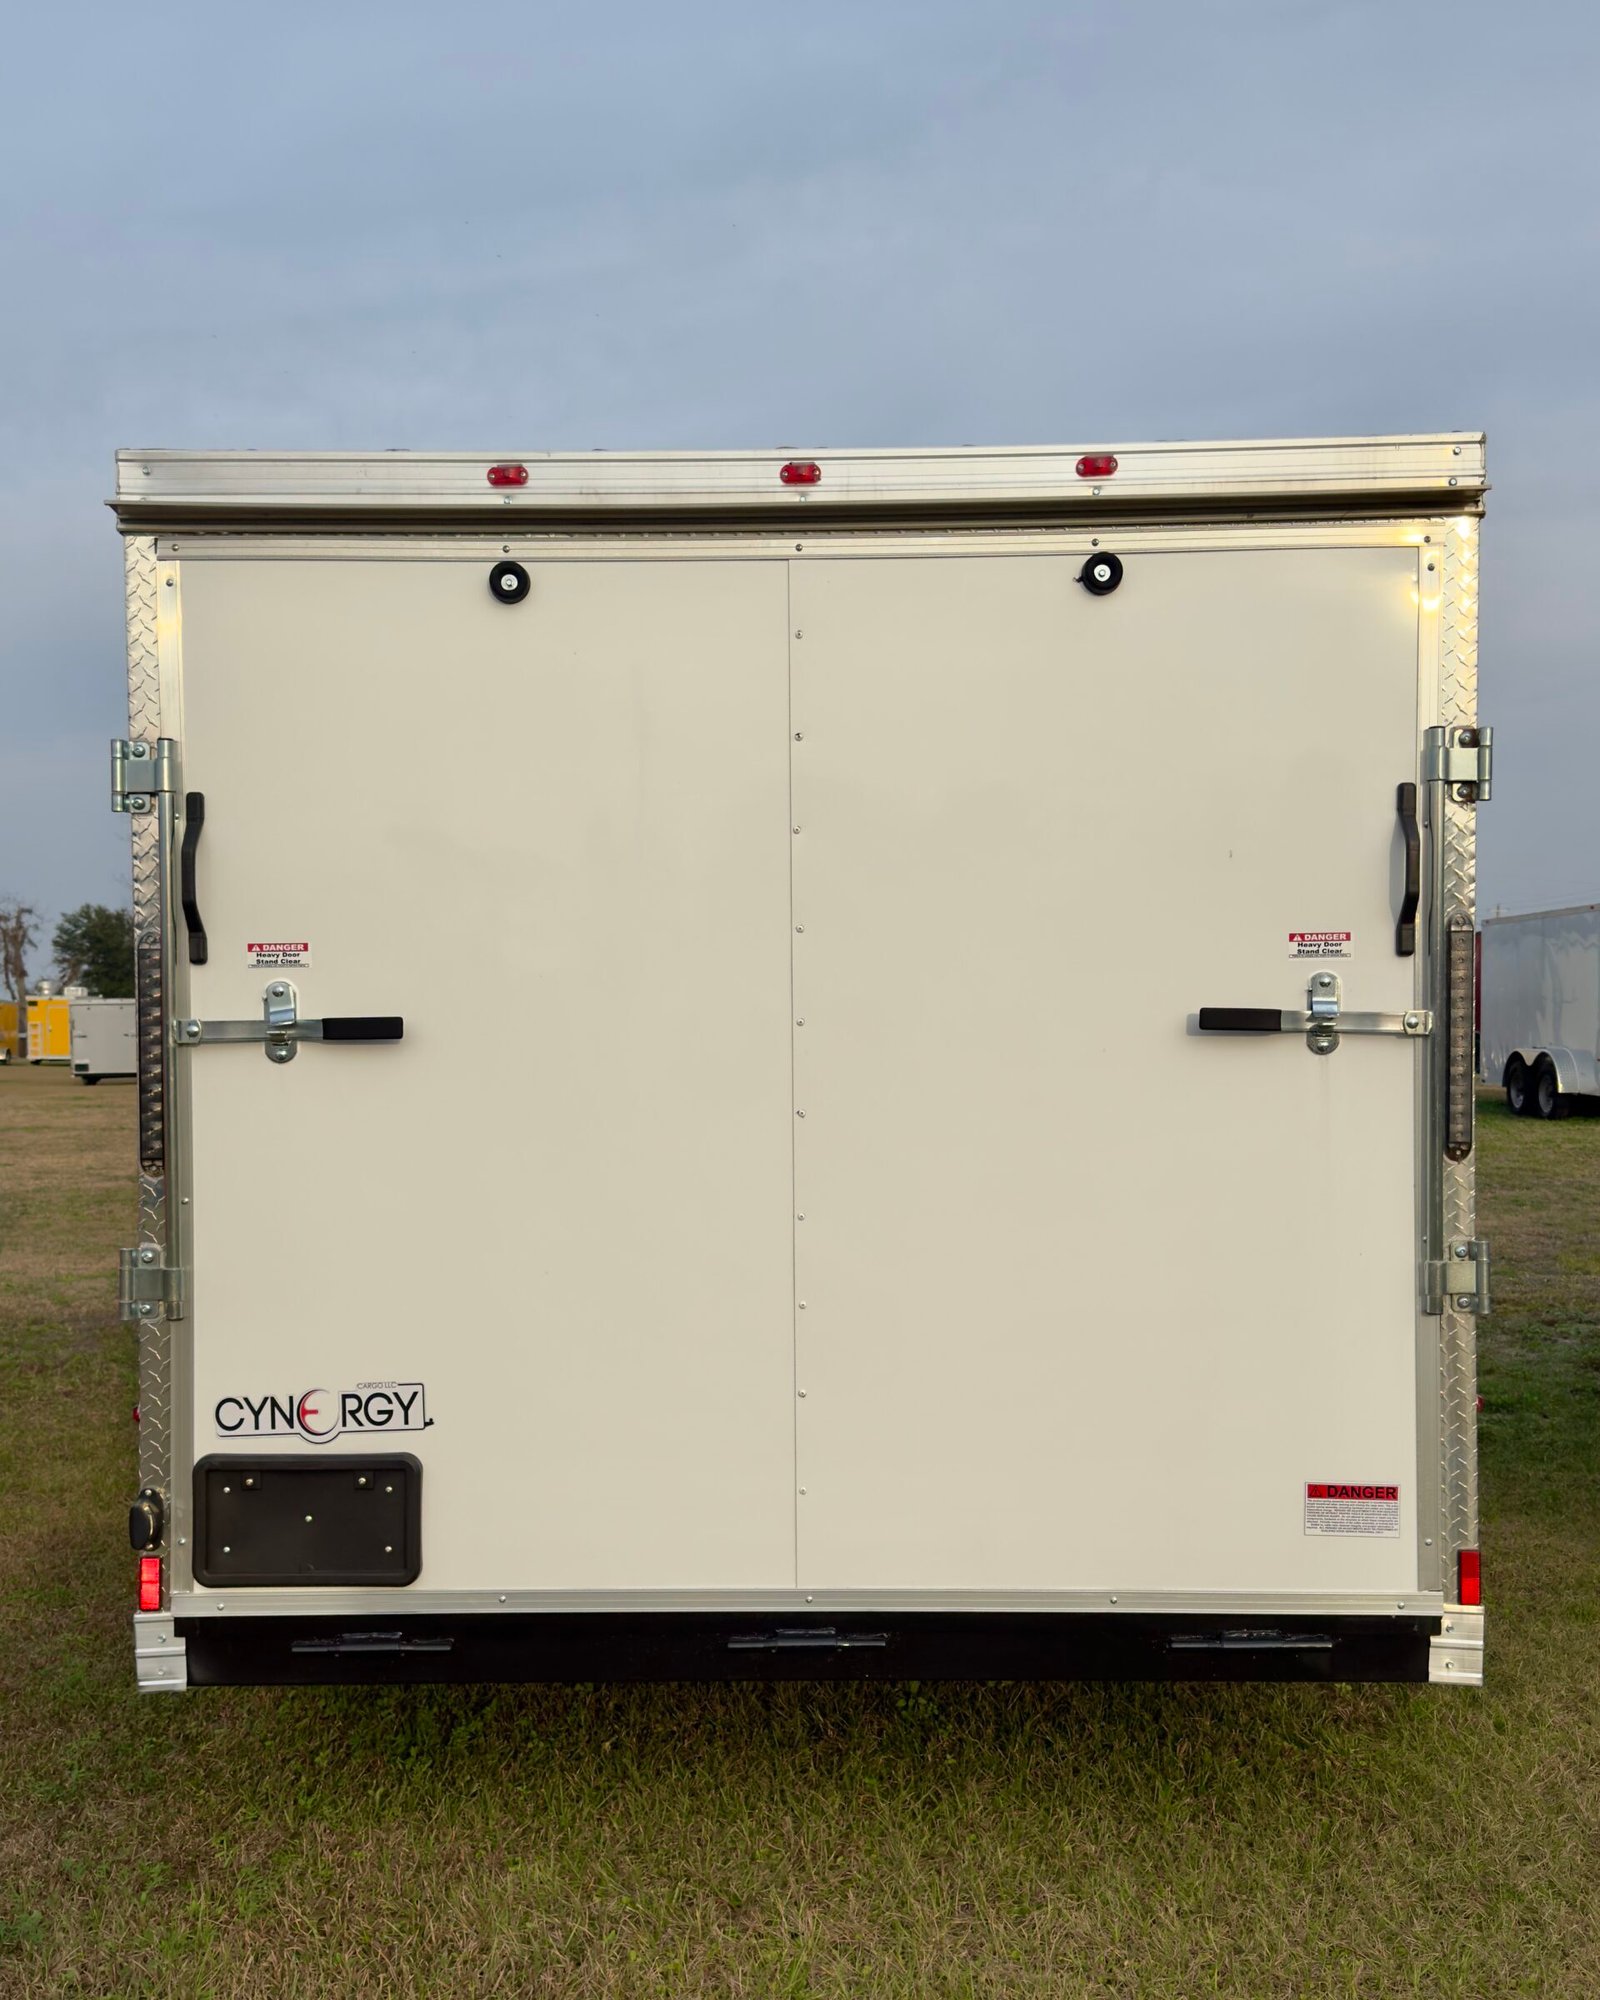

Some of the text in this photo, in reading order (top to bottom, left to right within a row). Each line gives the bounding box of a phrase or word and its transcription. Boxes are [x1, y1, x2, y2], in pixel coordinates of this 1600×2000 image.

[1304, 933, 1347, 941] DANGER
[356, 1381, 397, 1390] CARGO LLC
[215, 1389, 419, 1436] CYNERGY
[1326, 1485, 1397, 1499] DANGER
